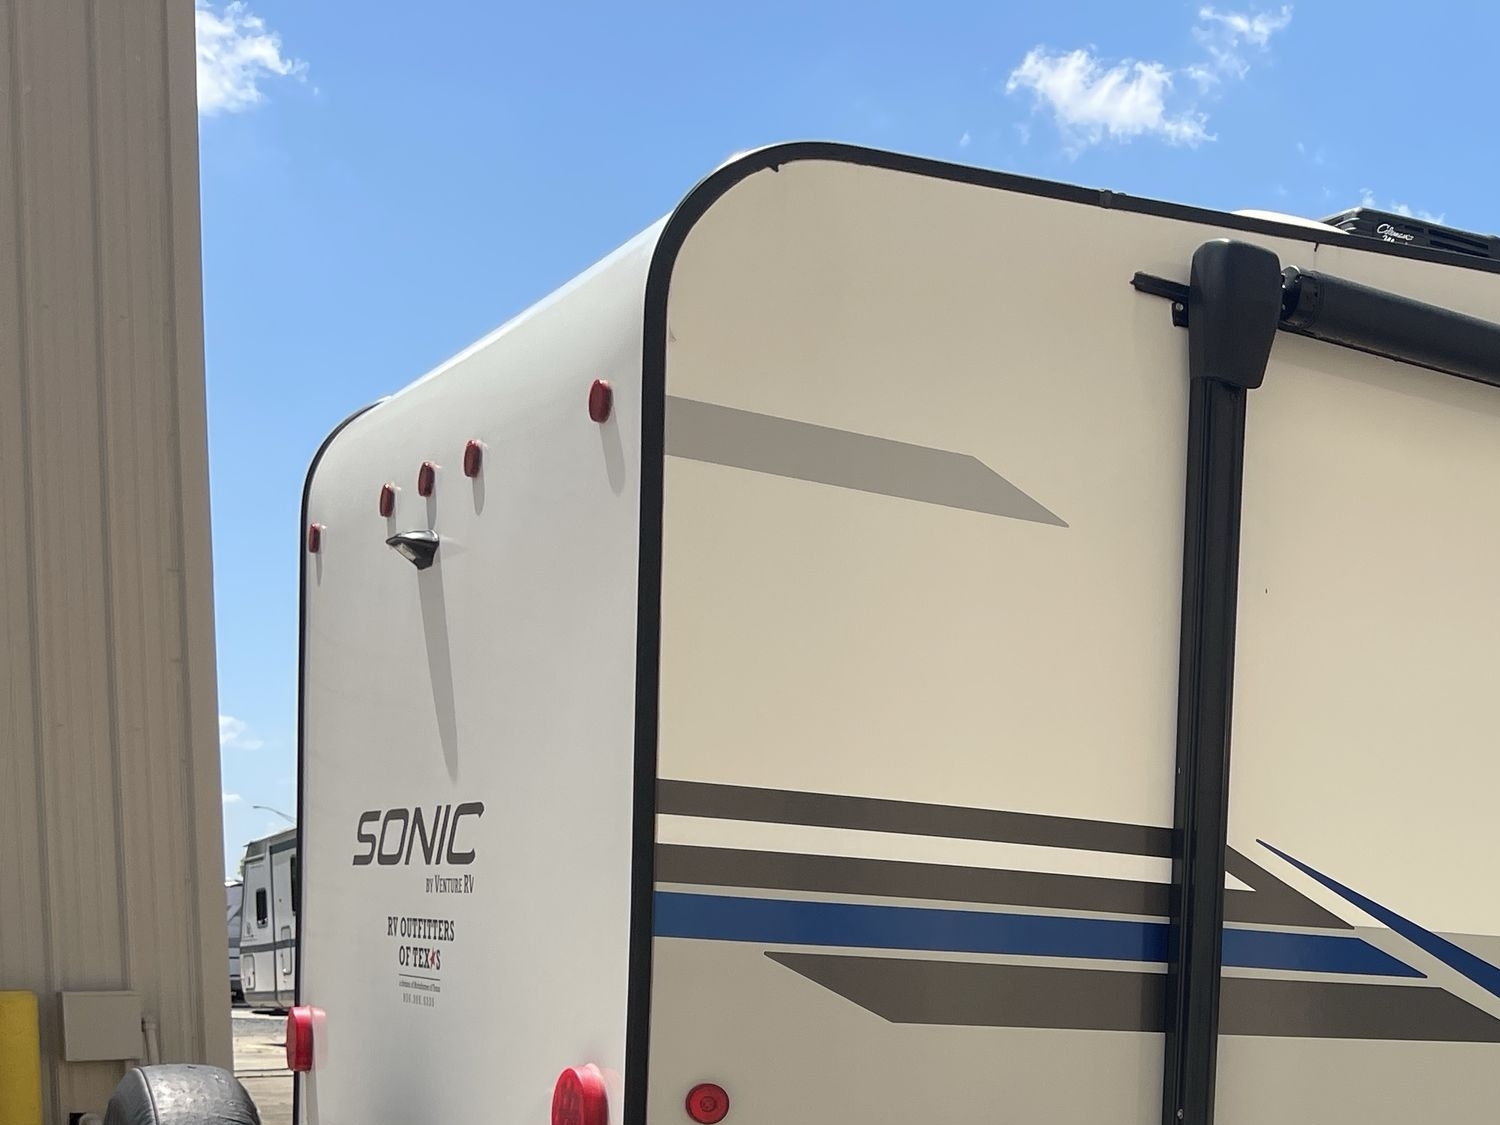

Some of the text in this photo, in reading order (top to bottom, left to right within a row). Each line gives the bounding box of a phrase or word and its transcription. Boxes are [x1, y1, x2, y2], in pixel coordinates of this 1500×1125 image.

[352, 801, 485, 866] SONIC
[463, 874, 475, 894] RV
[387, 916, 455, 942] RV OUTFITTERS
[399, 945, 411, 967] OF
